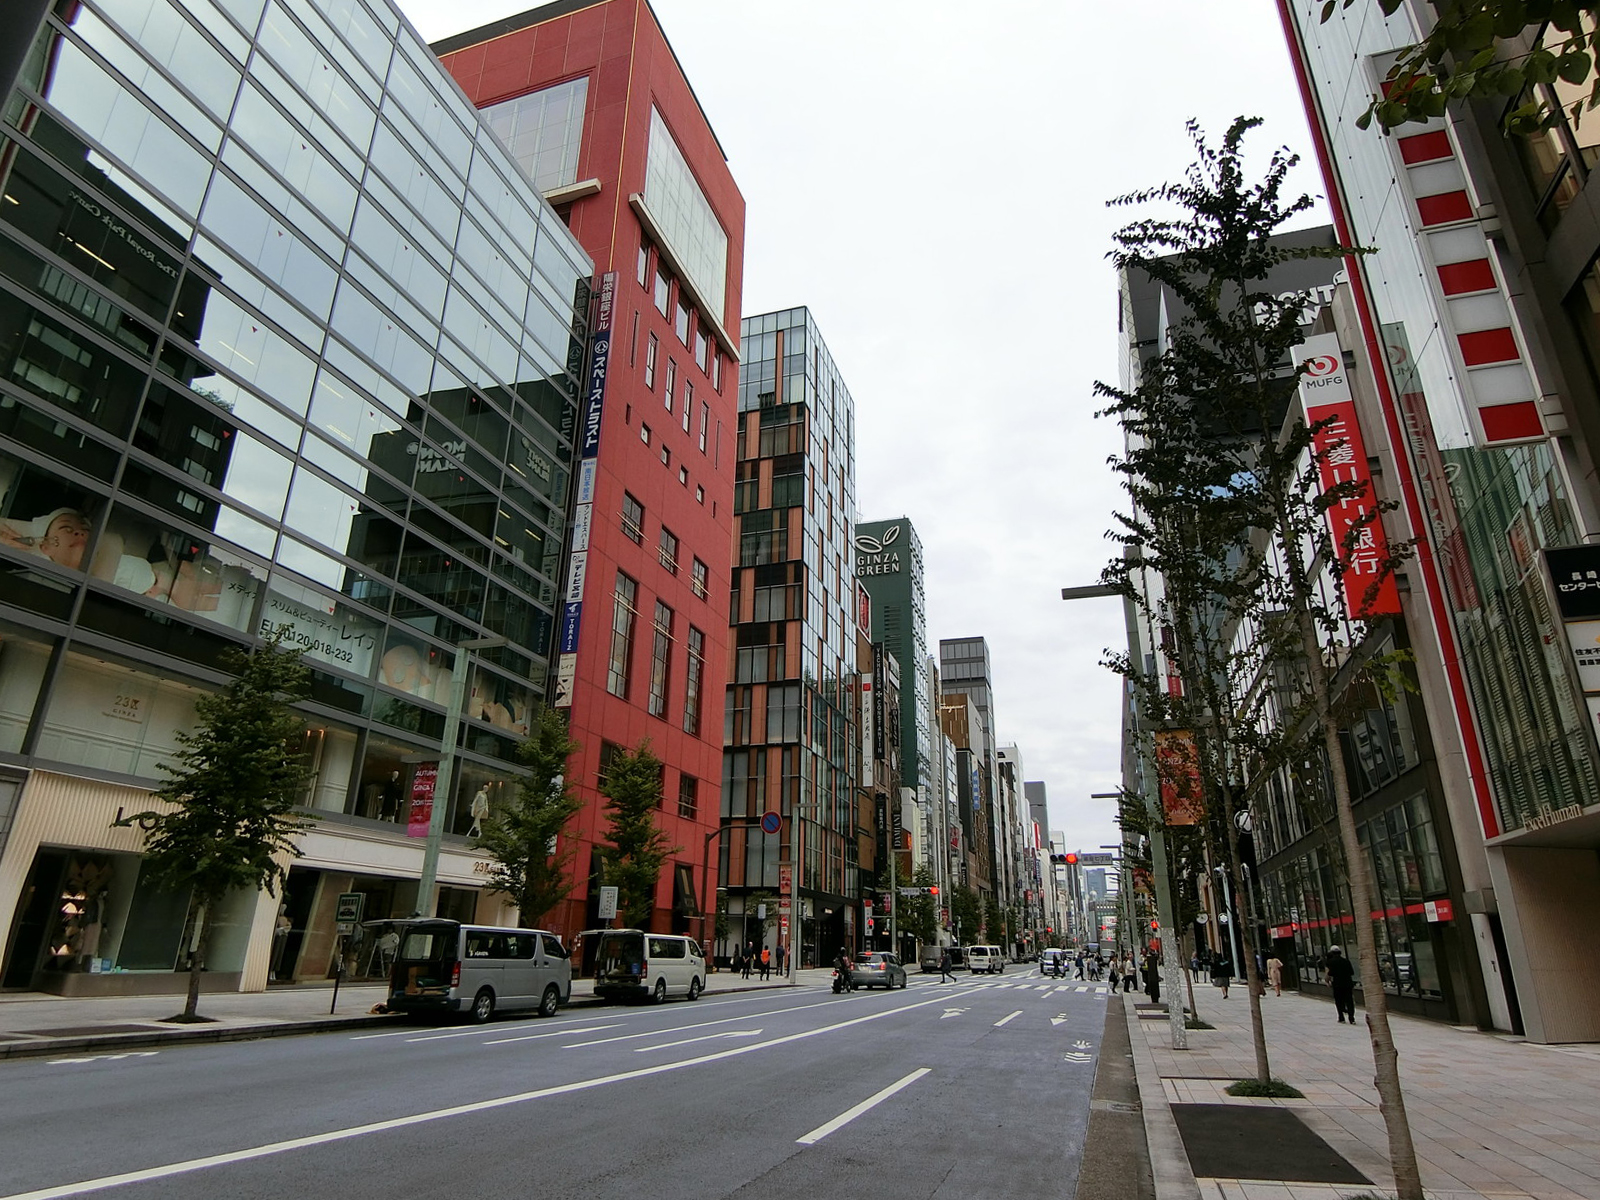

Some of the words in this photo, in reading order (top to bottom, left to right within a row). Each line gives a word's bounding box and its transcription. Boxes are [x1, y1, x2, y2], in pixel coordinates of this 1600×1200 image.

[1306, 376, 1343, 389] MUFG
[585, 356, 605, 448] スペーストラスト
[857, 552, 899, 566] GINZA
[857, 562, 900, 577] GREEN
